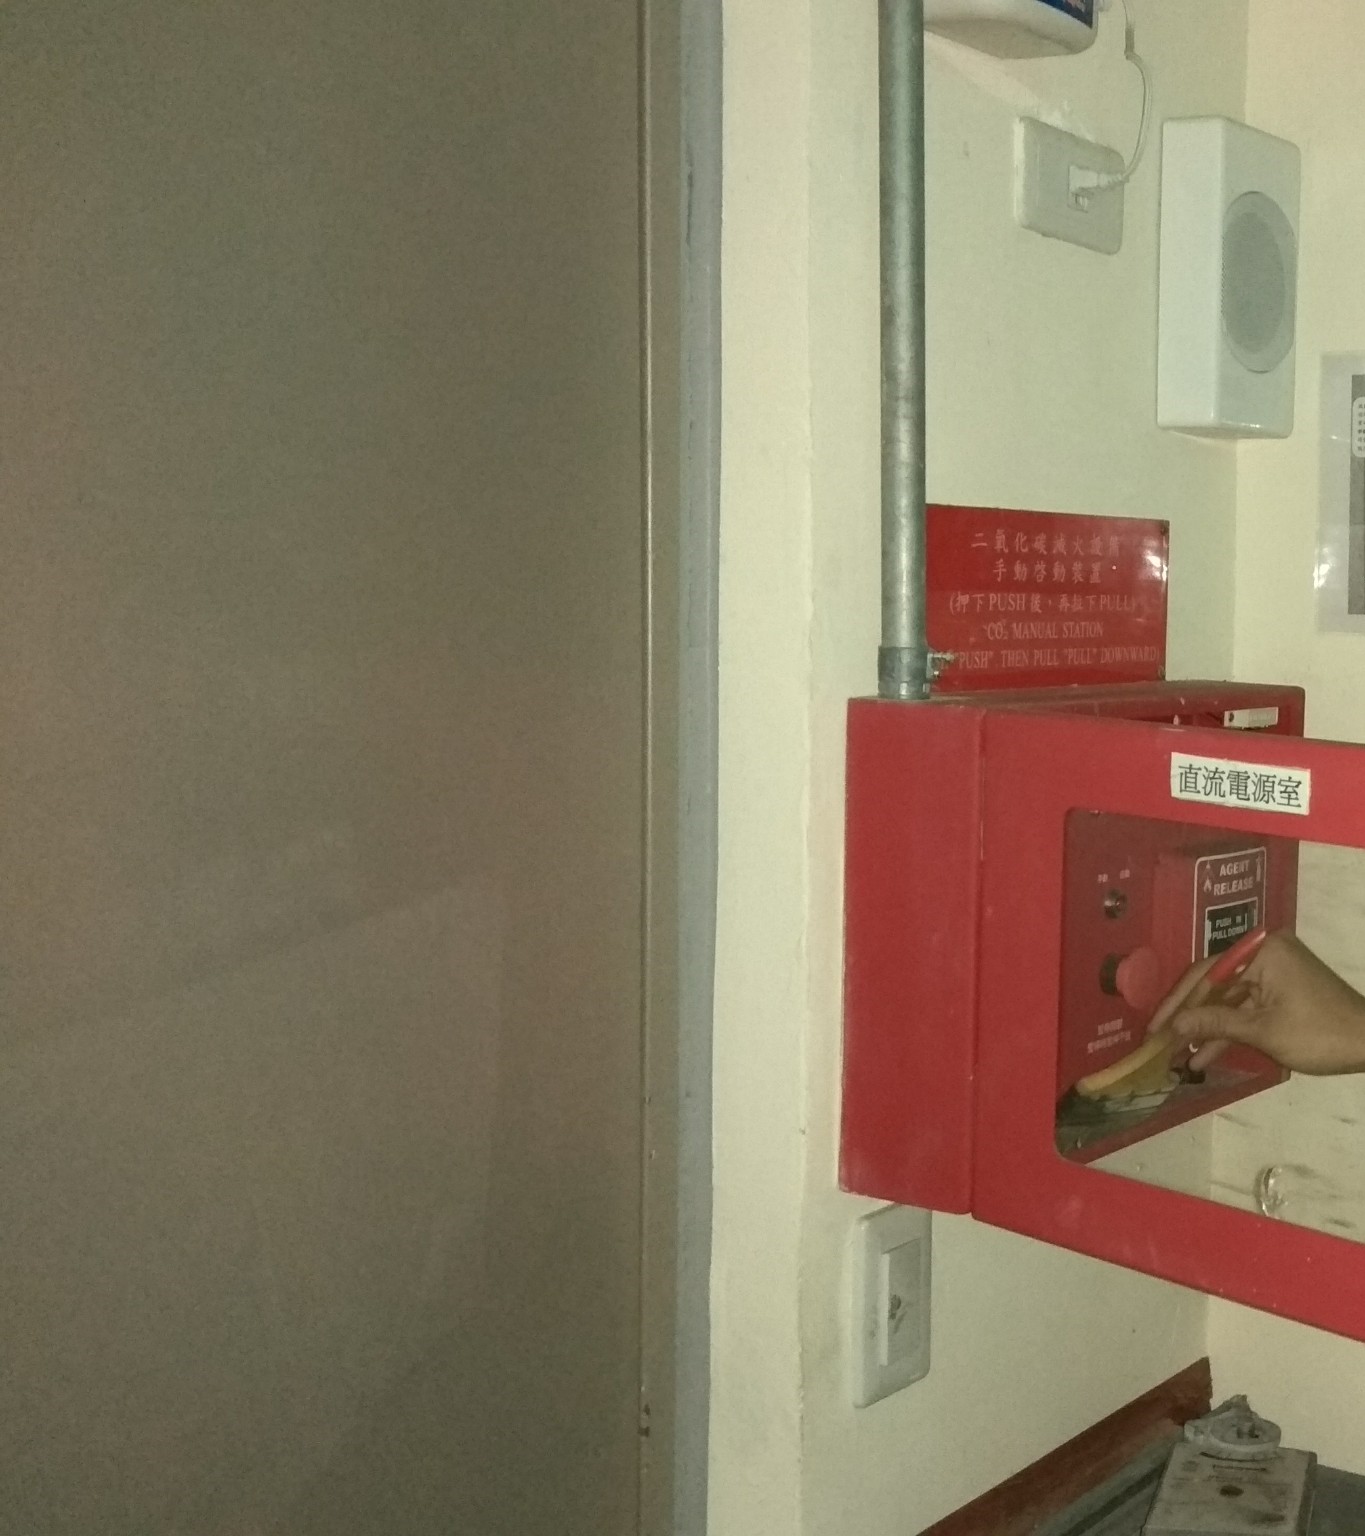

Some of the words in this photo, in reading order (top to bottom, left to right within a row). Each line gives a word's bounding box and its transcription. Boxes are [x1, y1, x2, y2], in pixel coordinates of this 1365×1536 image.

[1012, 622, 1059, 640] MANUAL
[1062, 621, 1104, 639] STATION
[1001, 649, 1030, 668] THEN
[1034, 648, 1060, 666] PULL
[1178, 763, 1302, 808] 直流電源室
[1220, 860, 1250, 876] AGENT
[1213, 877, 1254, 895] RELEASE
